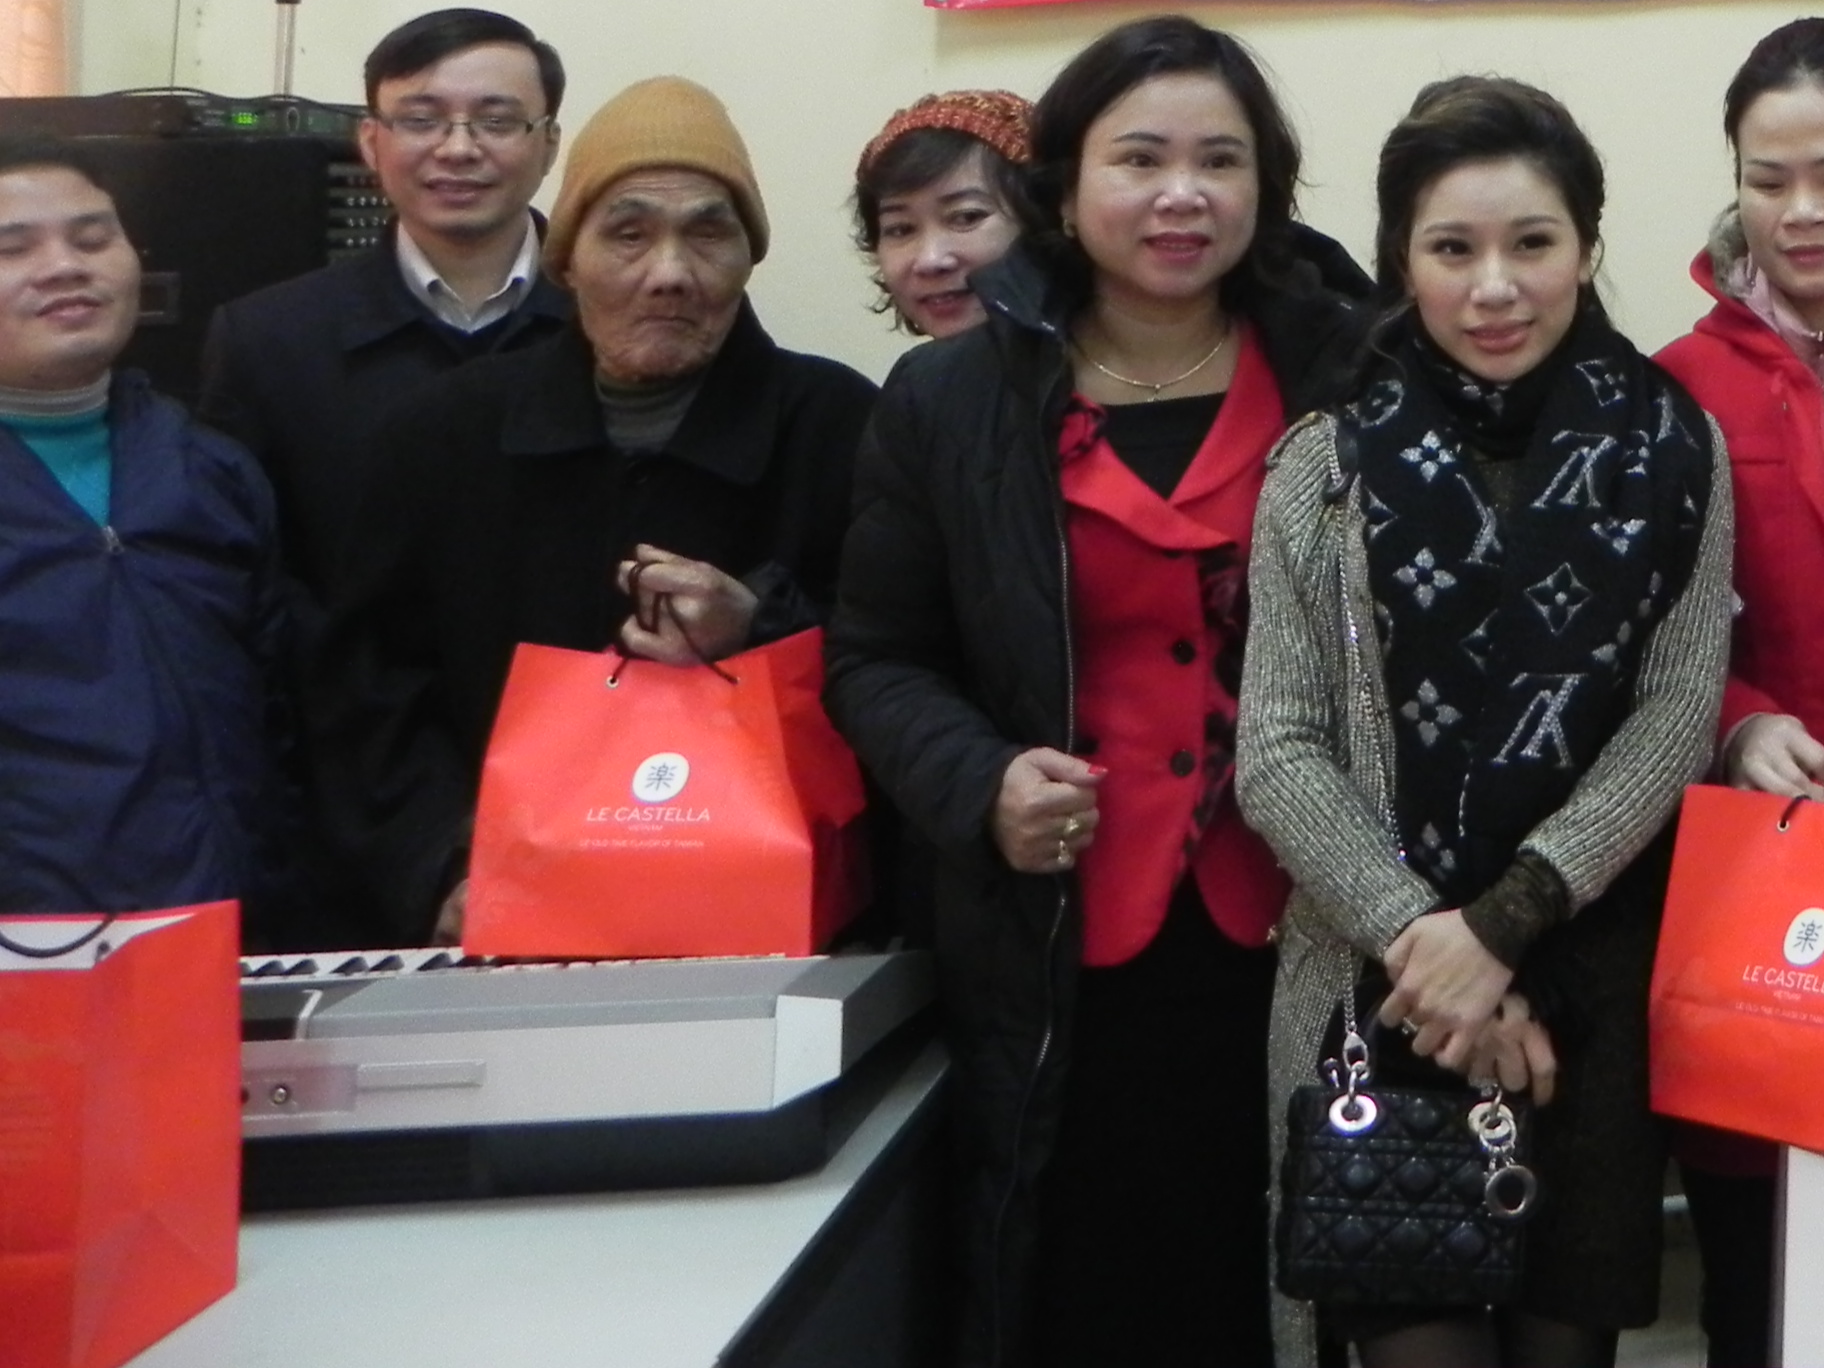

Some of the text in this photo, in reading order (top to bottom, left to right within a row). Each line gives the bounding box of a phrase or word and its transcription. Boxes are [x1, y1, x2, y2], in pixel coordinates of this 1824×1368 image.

[586, 806, 711, 822] LE CASTELLA
[1742, 964, 1764, 983] LE
